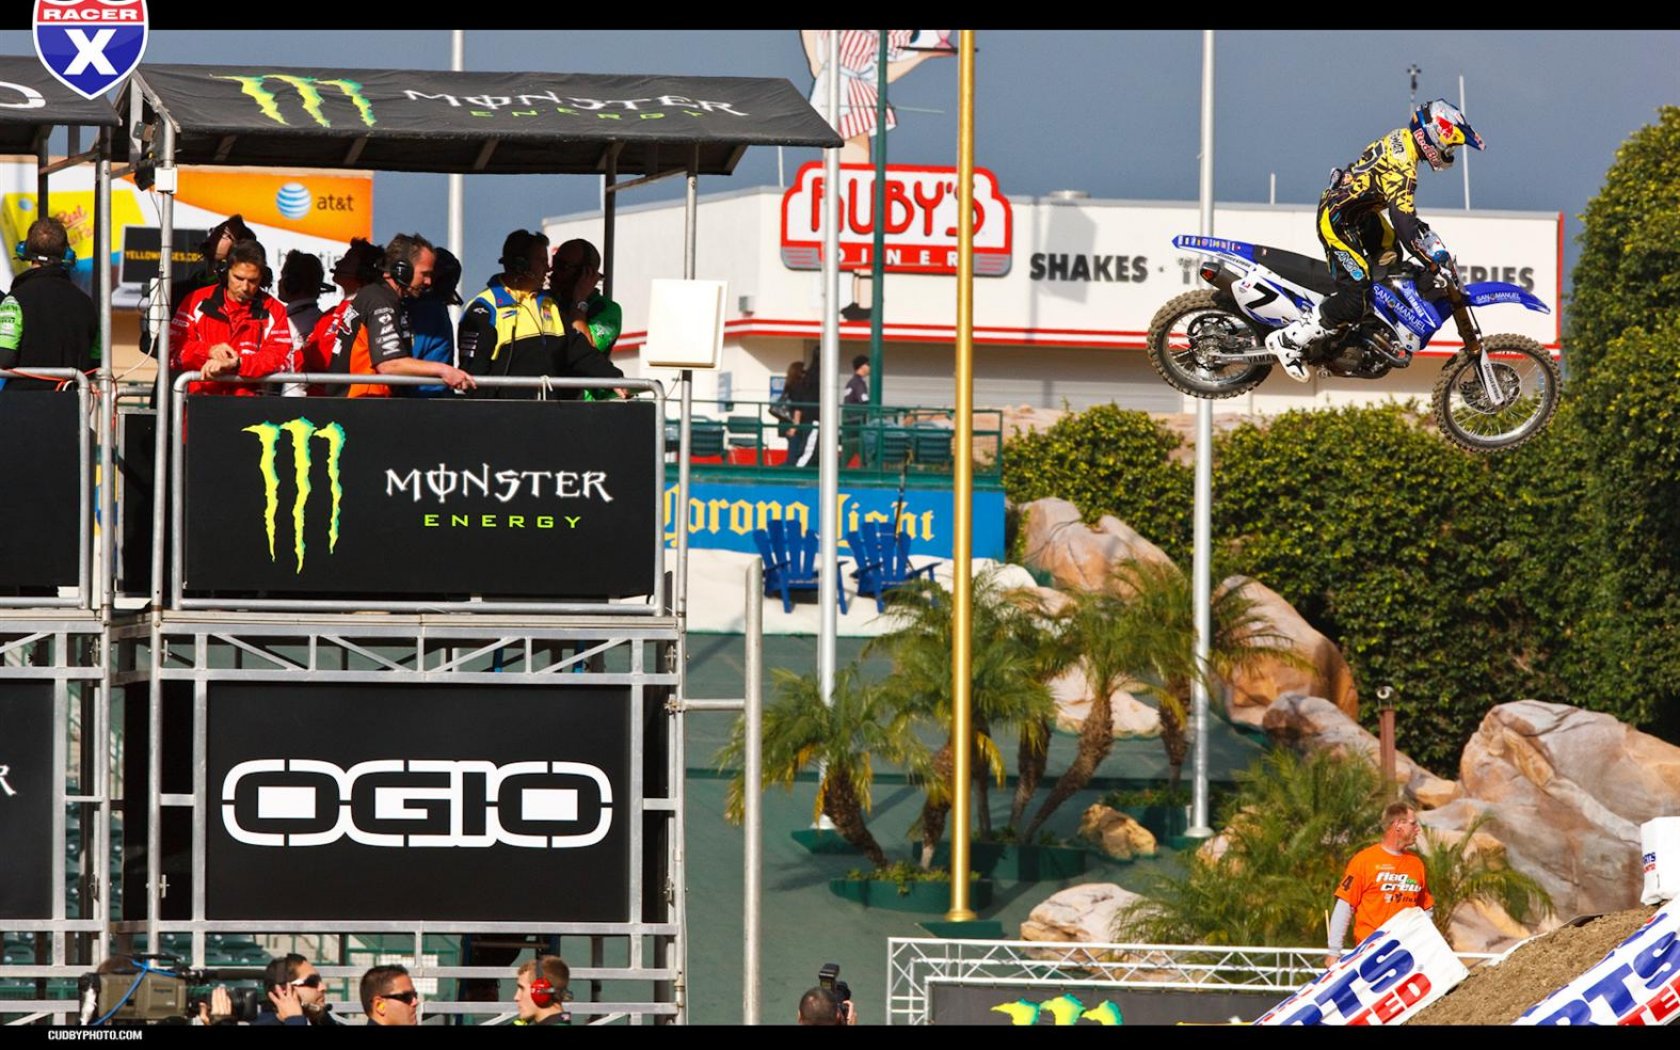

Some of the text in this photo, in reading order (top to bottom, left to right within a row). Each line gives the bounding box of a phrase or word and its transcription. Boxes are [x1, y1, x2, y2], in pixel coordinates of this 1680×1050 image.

[470, 106, 702, 120] ENERGY
[317, 194, 355, 212] at&t
[838, 248, 959, 266] INER
[1030, 253, 1149, 284] SHAKES
[1245, 282, 1279, 309] 7
[1373, 285, 1427, 331] SAN MANUEL
[385, 463, 613, 503] MONSTER
[424, 514, 581, 529] ENERGY
[836, 493, 935, 548] Liht
[221, 759, 613, 848] OGIO
